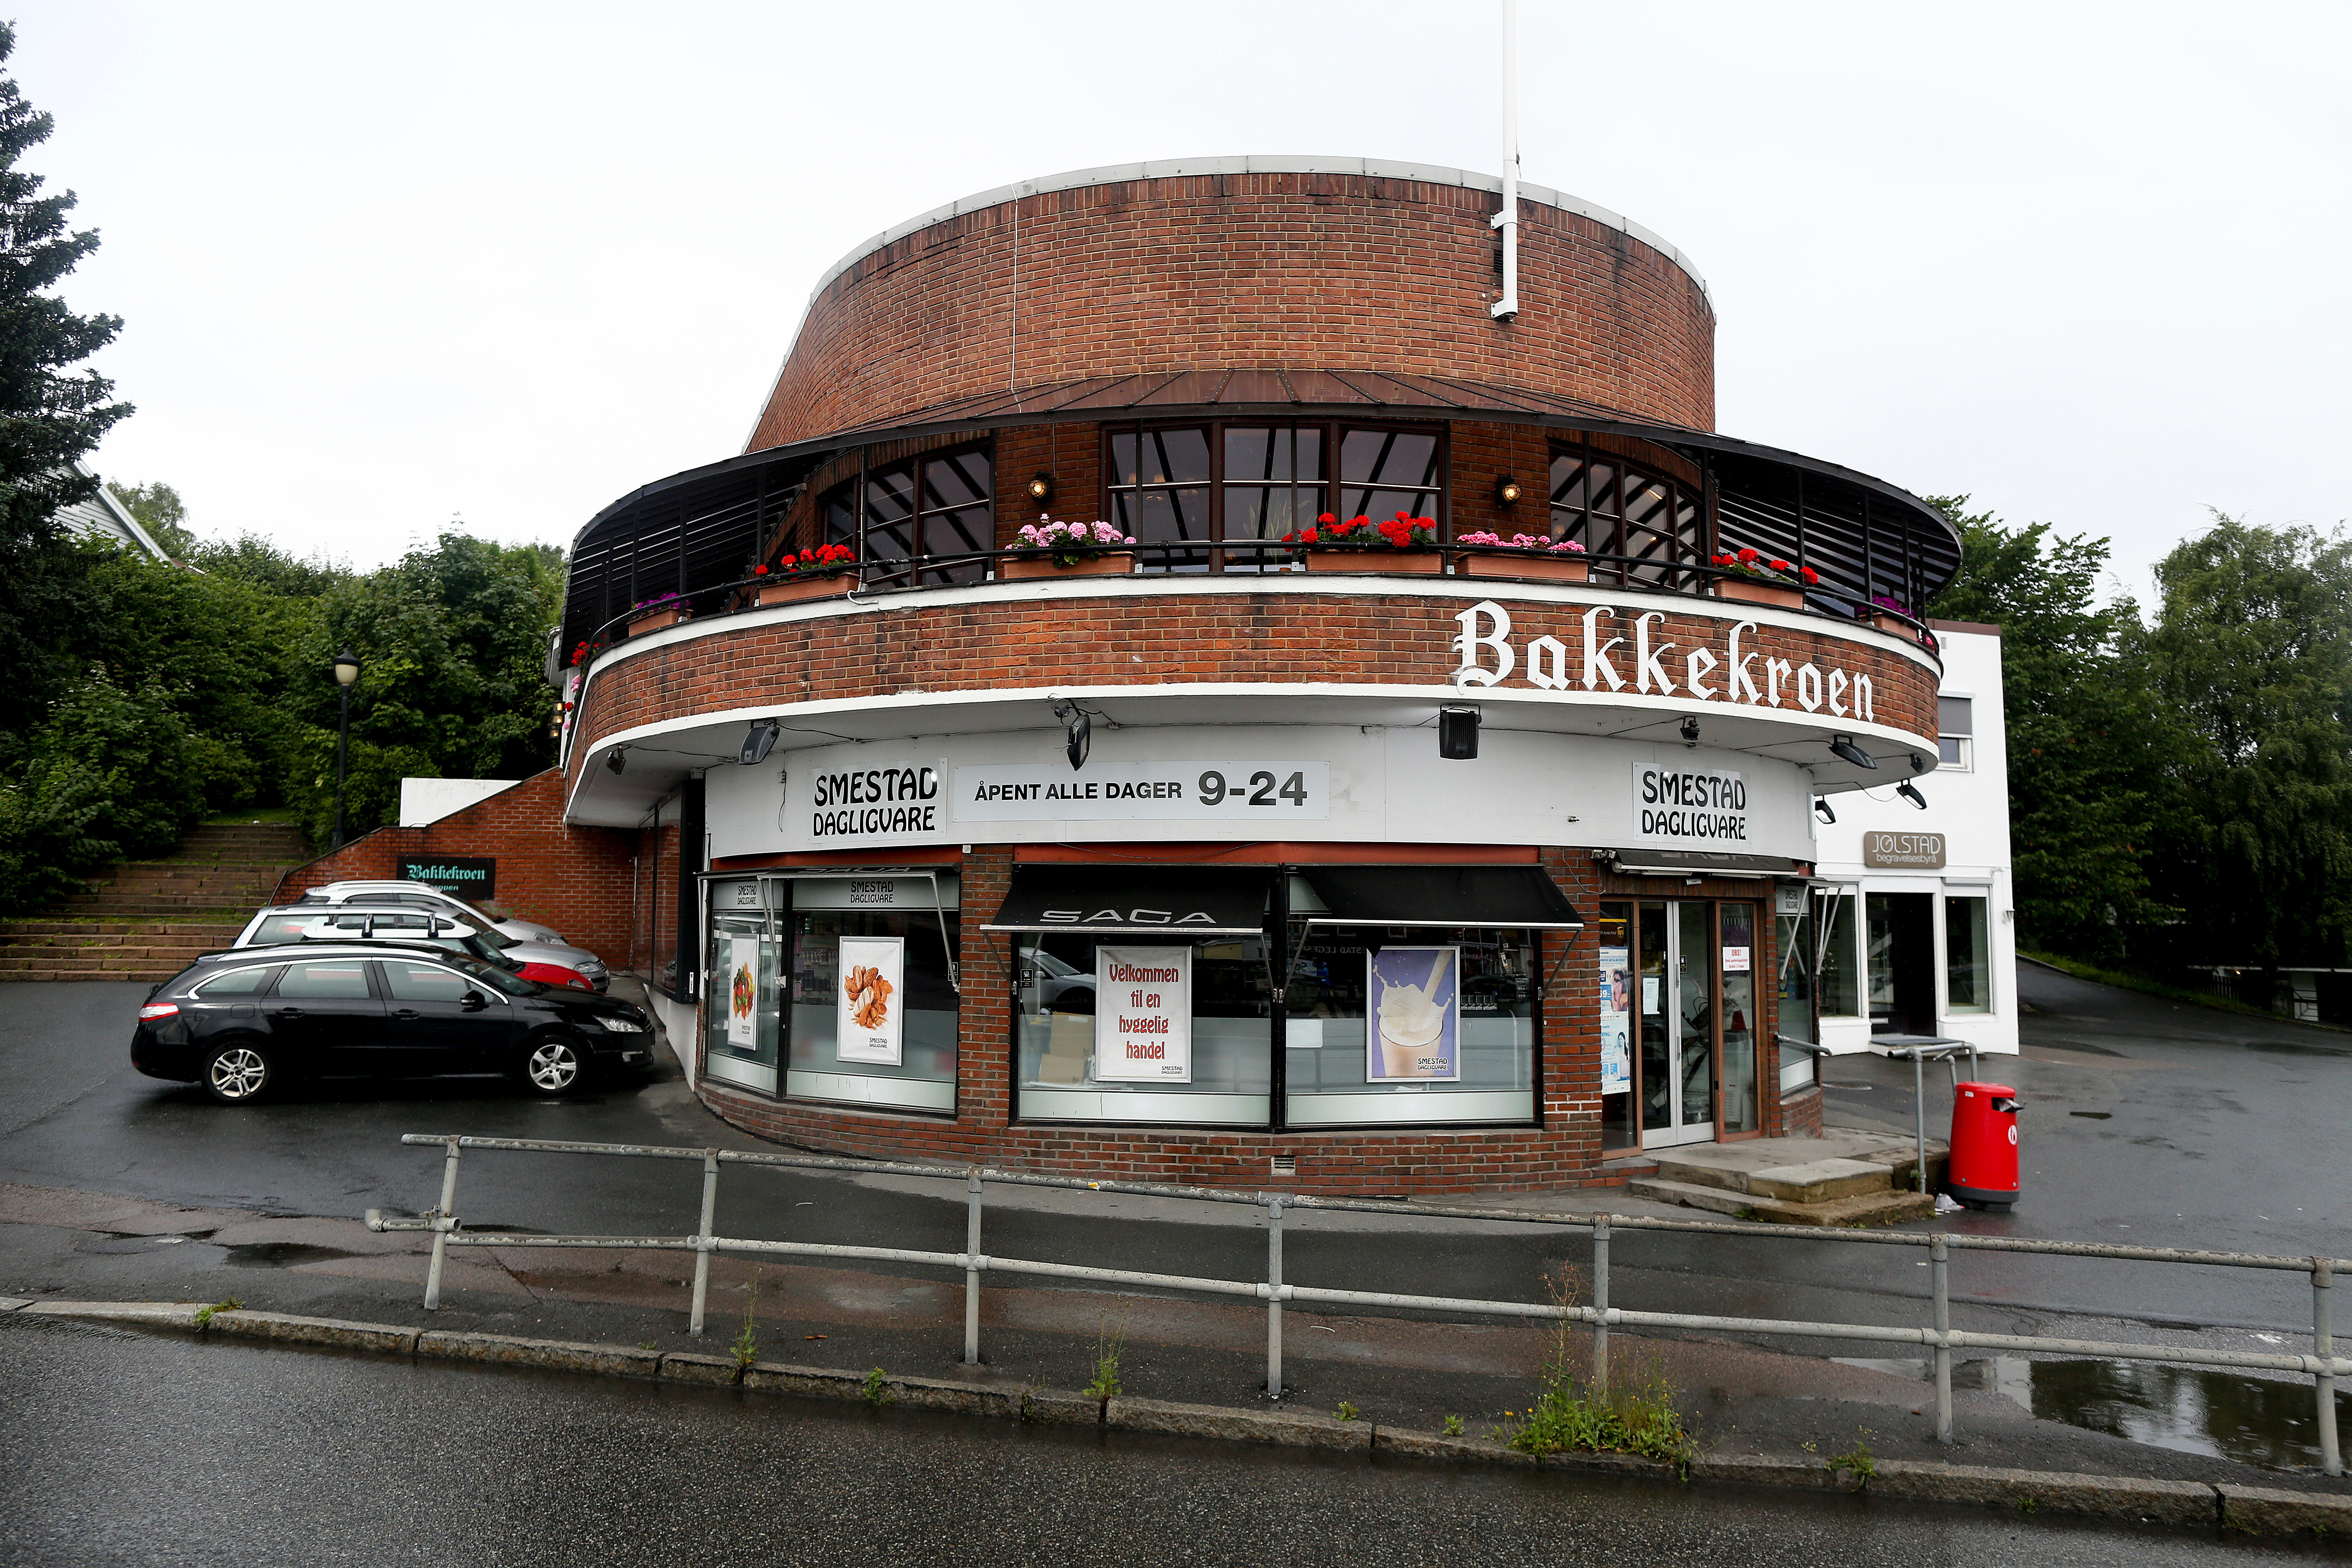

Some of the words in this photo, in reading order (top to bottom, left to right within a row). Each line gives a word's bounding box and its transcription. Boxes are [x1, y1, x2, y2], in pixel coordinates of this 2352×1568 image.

[1452, 599, 1874, 722] Bakkekroen
[814, 767, 937, 807] SMESTAD
[975, 780, 1041, 801] ÅPENT
[1045, 783, 1098, 800] ALLE
[1106, 782, 1182, 799] DAGER
[1199, 771, 1307, 806] 9-24
[1642, 770, 1746, 811] SMESTAD
[813, 806, 935, 836] DAGLIGVARE
[1642, 809, 1746, 840] DAGLIGVARE
[1872, 834, 1941, 854] JØLSTAD
[1876, 853, 1937, 864] begravelsesbyrå
[406, 864, 486, 880] Bakkekroen
[738, 885, 757, 895] SMESTAD
[851, 881, 894, 893] SMESTAD
[851, 894, 893, 903] DAGLIGVARE
[1040, 909, 1216, 924] SAGA
[1109, 963, 1179, 982] Velkommen
[1131, 990, 1143, 1008] til
[1146, 994, 1160, 1008] en
[1119, 1015, 1169, 1034] hyggelig
[1126, 1041, 1165, 1060] handel
